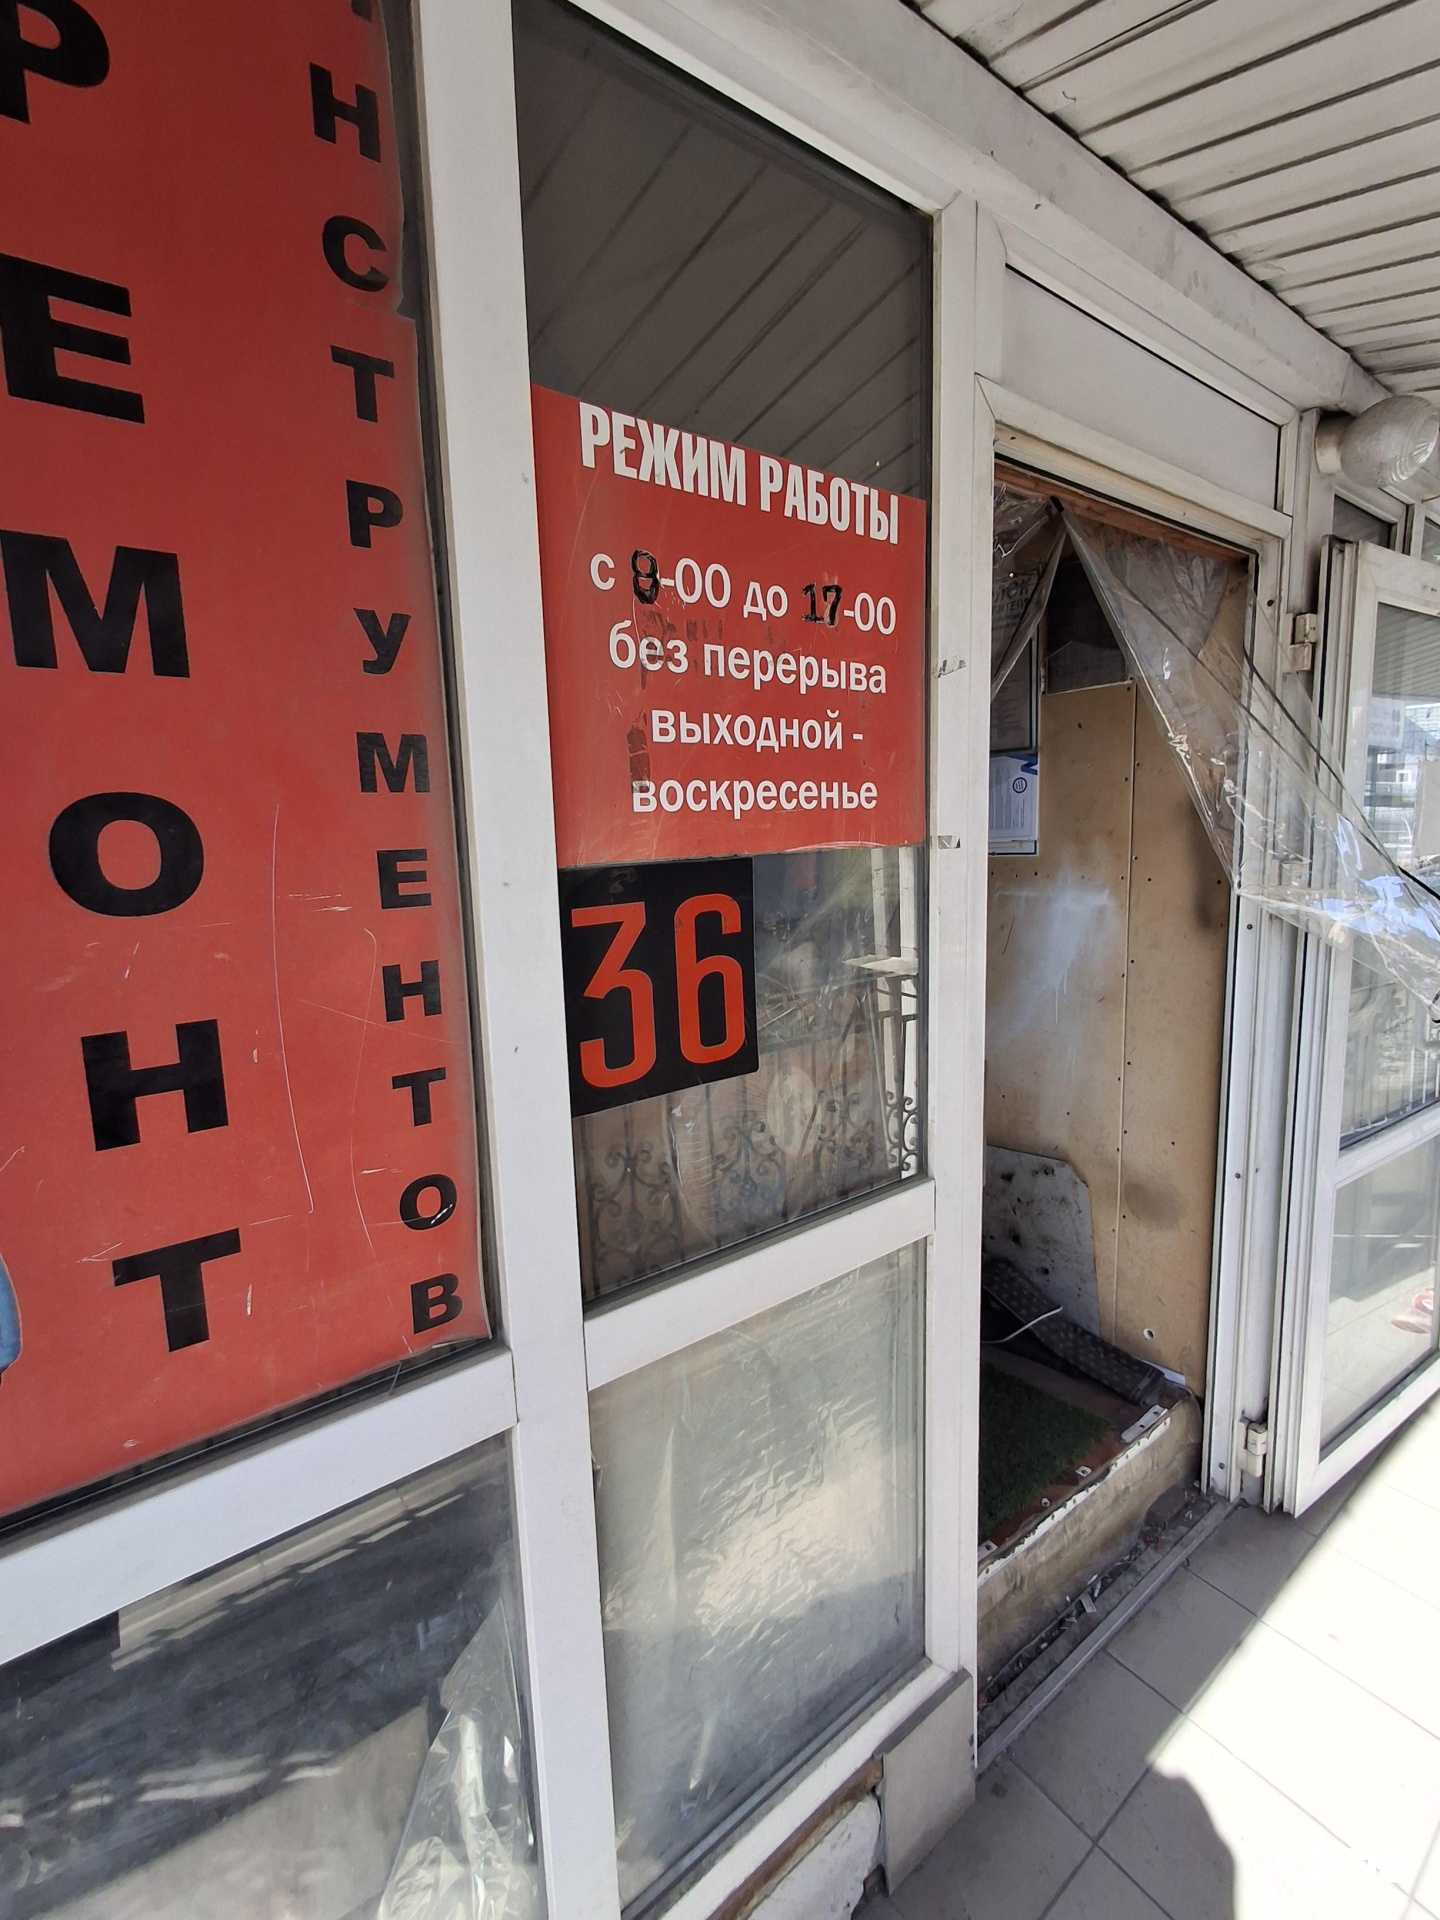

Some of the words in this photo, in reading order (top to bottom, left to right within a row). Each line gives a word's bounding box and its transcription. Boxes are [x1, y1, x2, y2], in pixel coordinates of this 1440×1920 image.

[579, 401, 747, 507] РЕЖИМ
[759, 455, 899, 545] РАБОТЫ
[590, 552, 616, 591] с
[742, 580, 789, 621] до
[801, 582, 897, 636] 17-00
[0, 0, 241, 1352] РЕМОНТ
[309, 0, 463, 1335] НСТРУМЕНТОВ
[609, 619, 689, 675] без
[703, 642, 887, 695] перерыва
[651, 708, 843, 753] выходной
[631, 777, 878, 820] воскресенье
[571, 892, 746, 1088] 36
